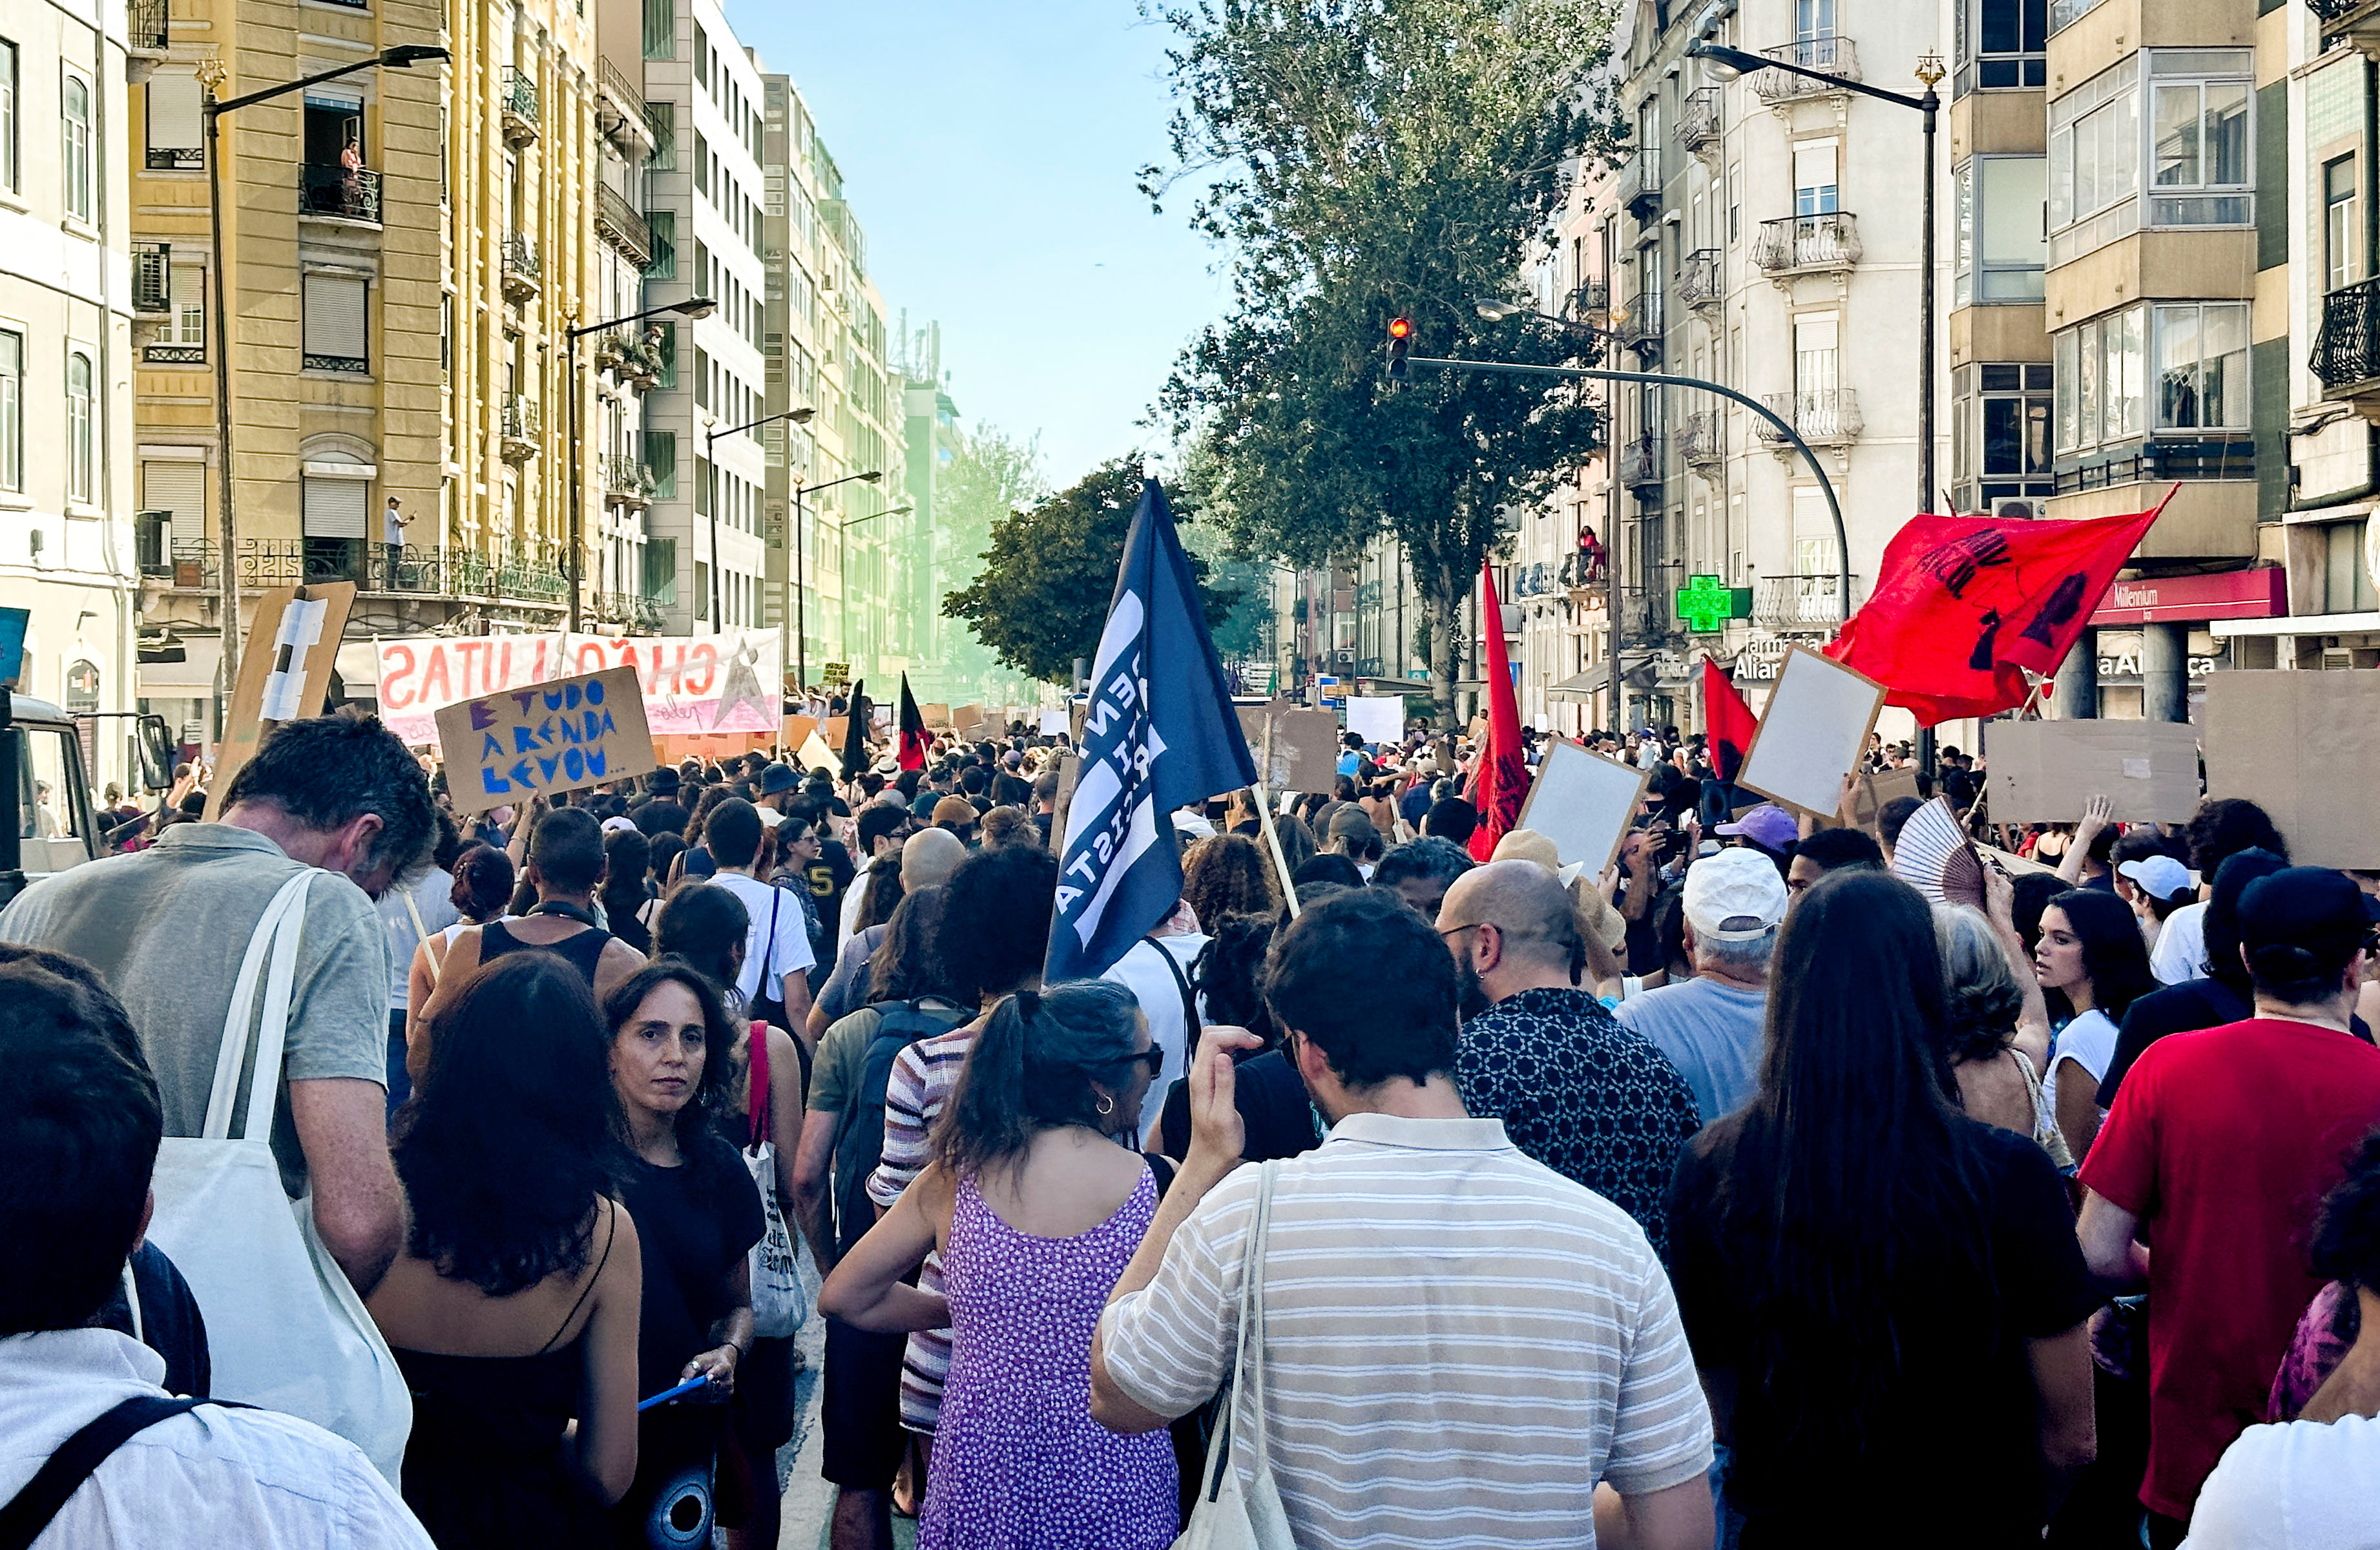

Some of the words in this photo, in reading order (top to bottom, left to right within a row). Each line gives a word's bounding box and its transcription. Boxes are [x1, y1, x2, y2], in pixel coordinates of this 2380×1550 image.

[2114, 583, 2158, 608] Millennium
[470, 698, 498, 731] E
[510, 679, 604, 717] TUDO
[481, 731, 505, 764] A
[513, 707, 617, 754] RENDA
[809, 866, 834, 896] 5
